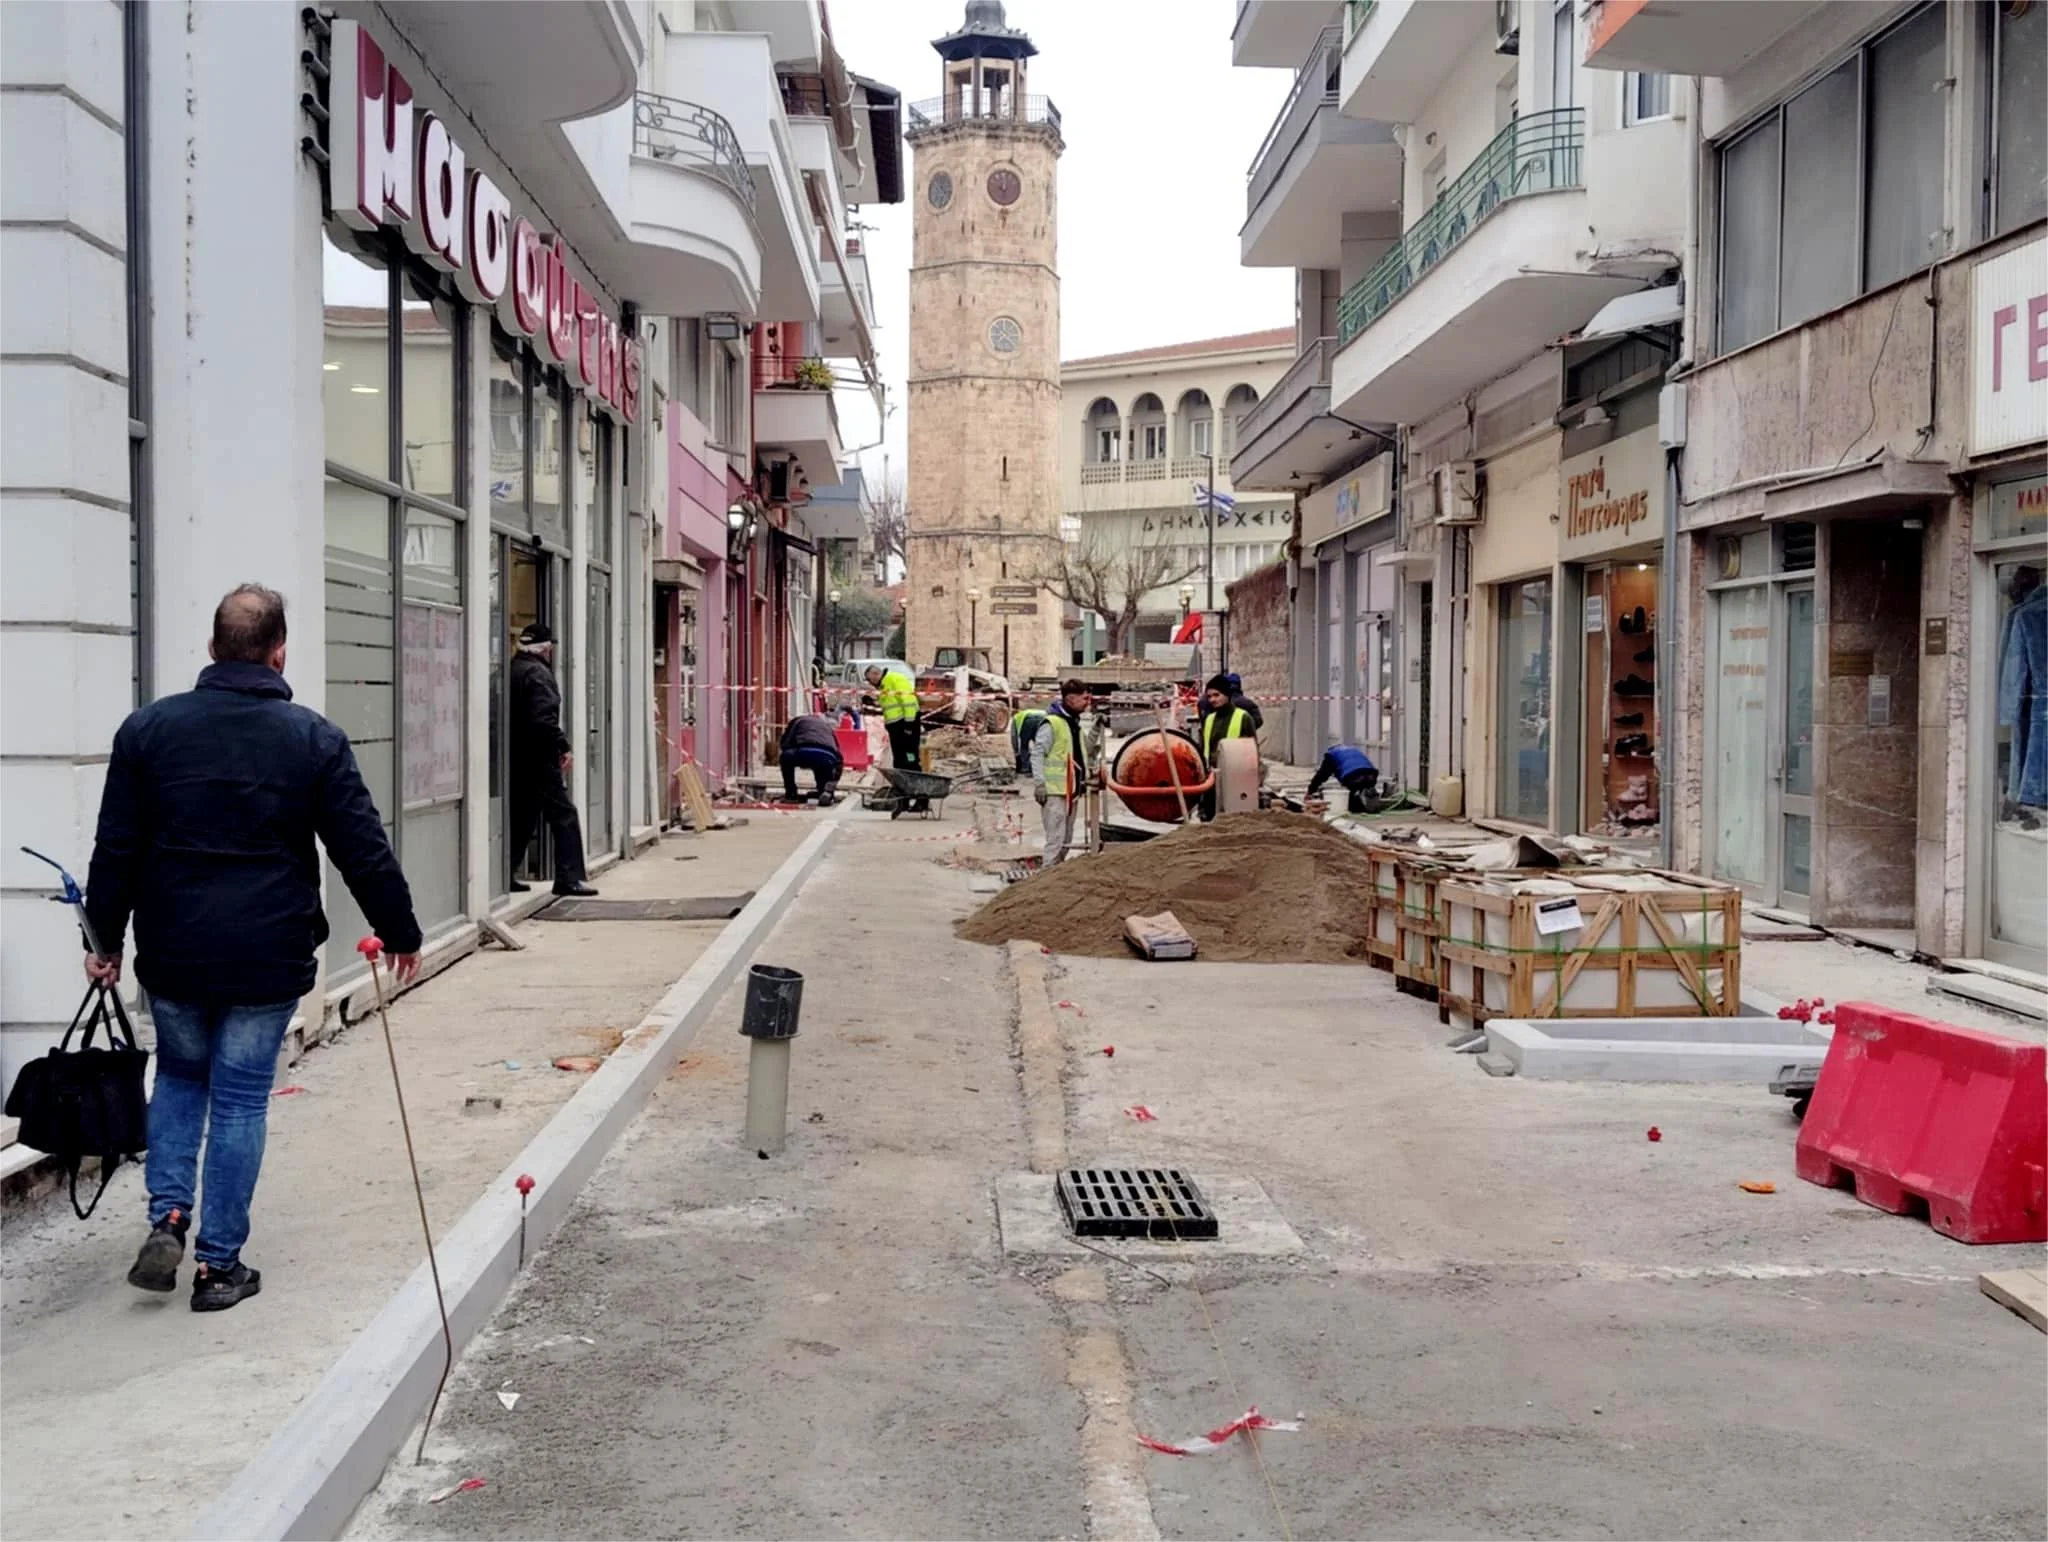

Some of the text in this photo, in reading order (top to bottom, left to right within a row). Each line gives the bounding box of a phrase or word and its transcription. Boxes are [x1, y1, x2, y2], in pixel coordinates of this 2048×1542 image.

[356, 22, 642, 425] Μασούτης
[1993, 294, 2048, 393] ΓΕ
[1142, 510, 1293, 532] ΔΗΜΑΡΧΕΙΟ
